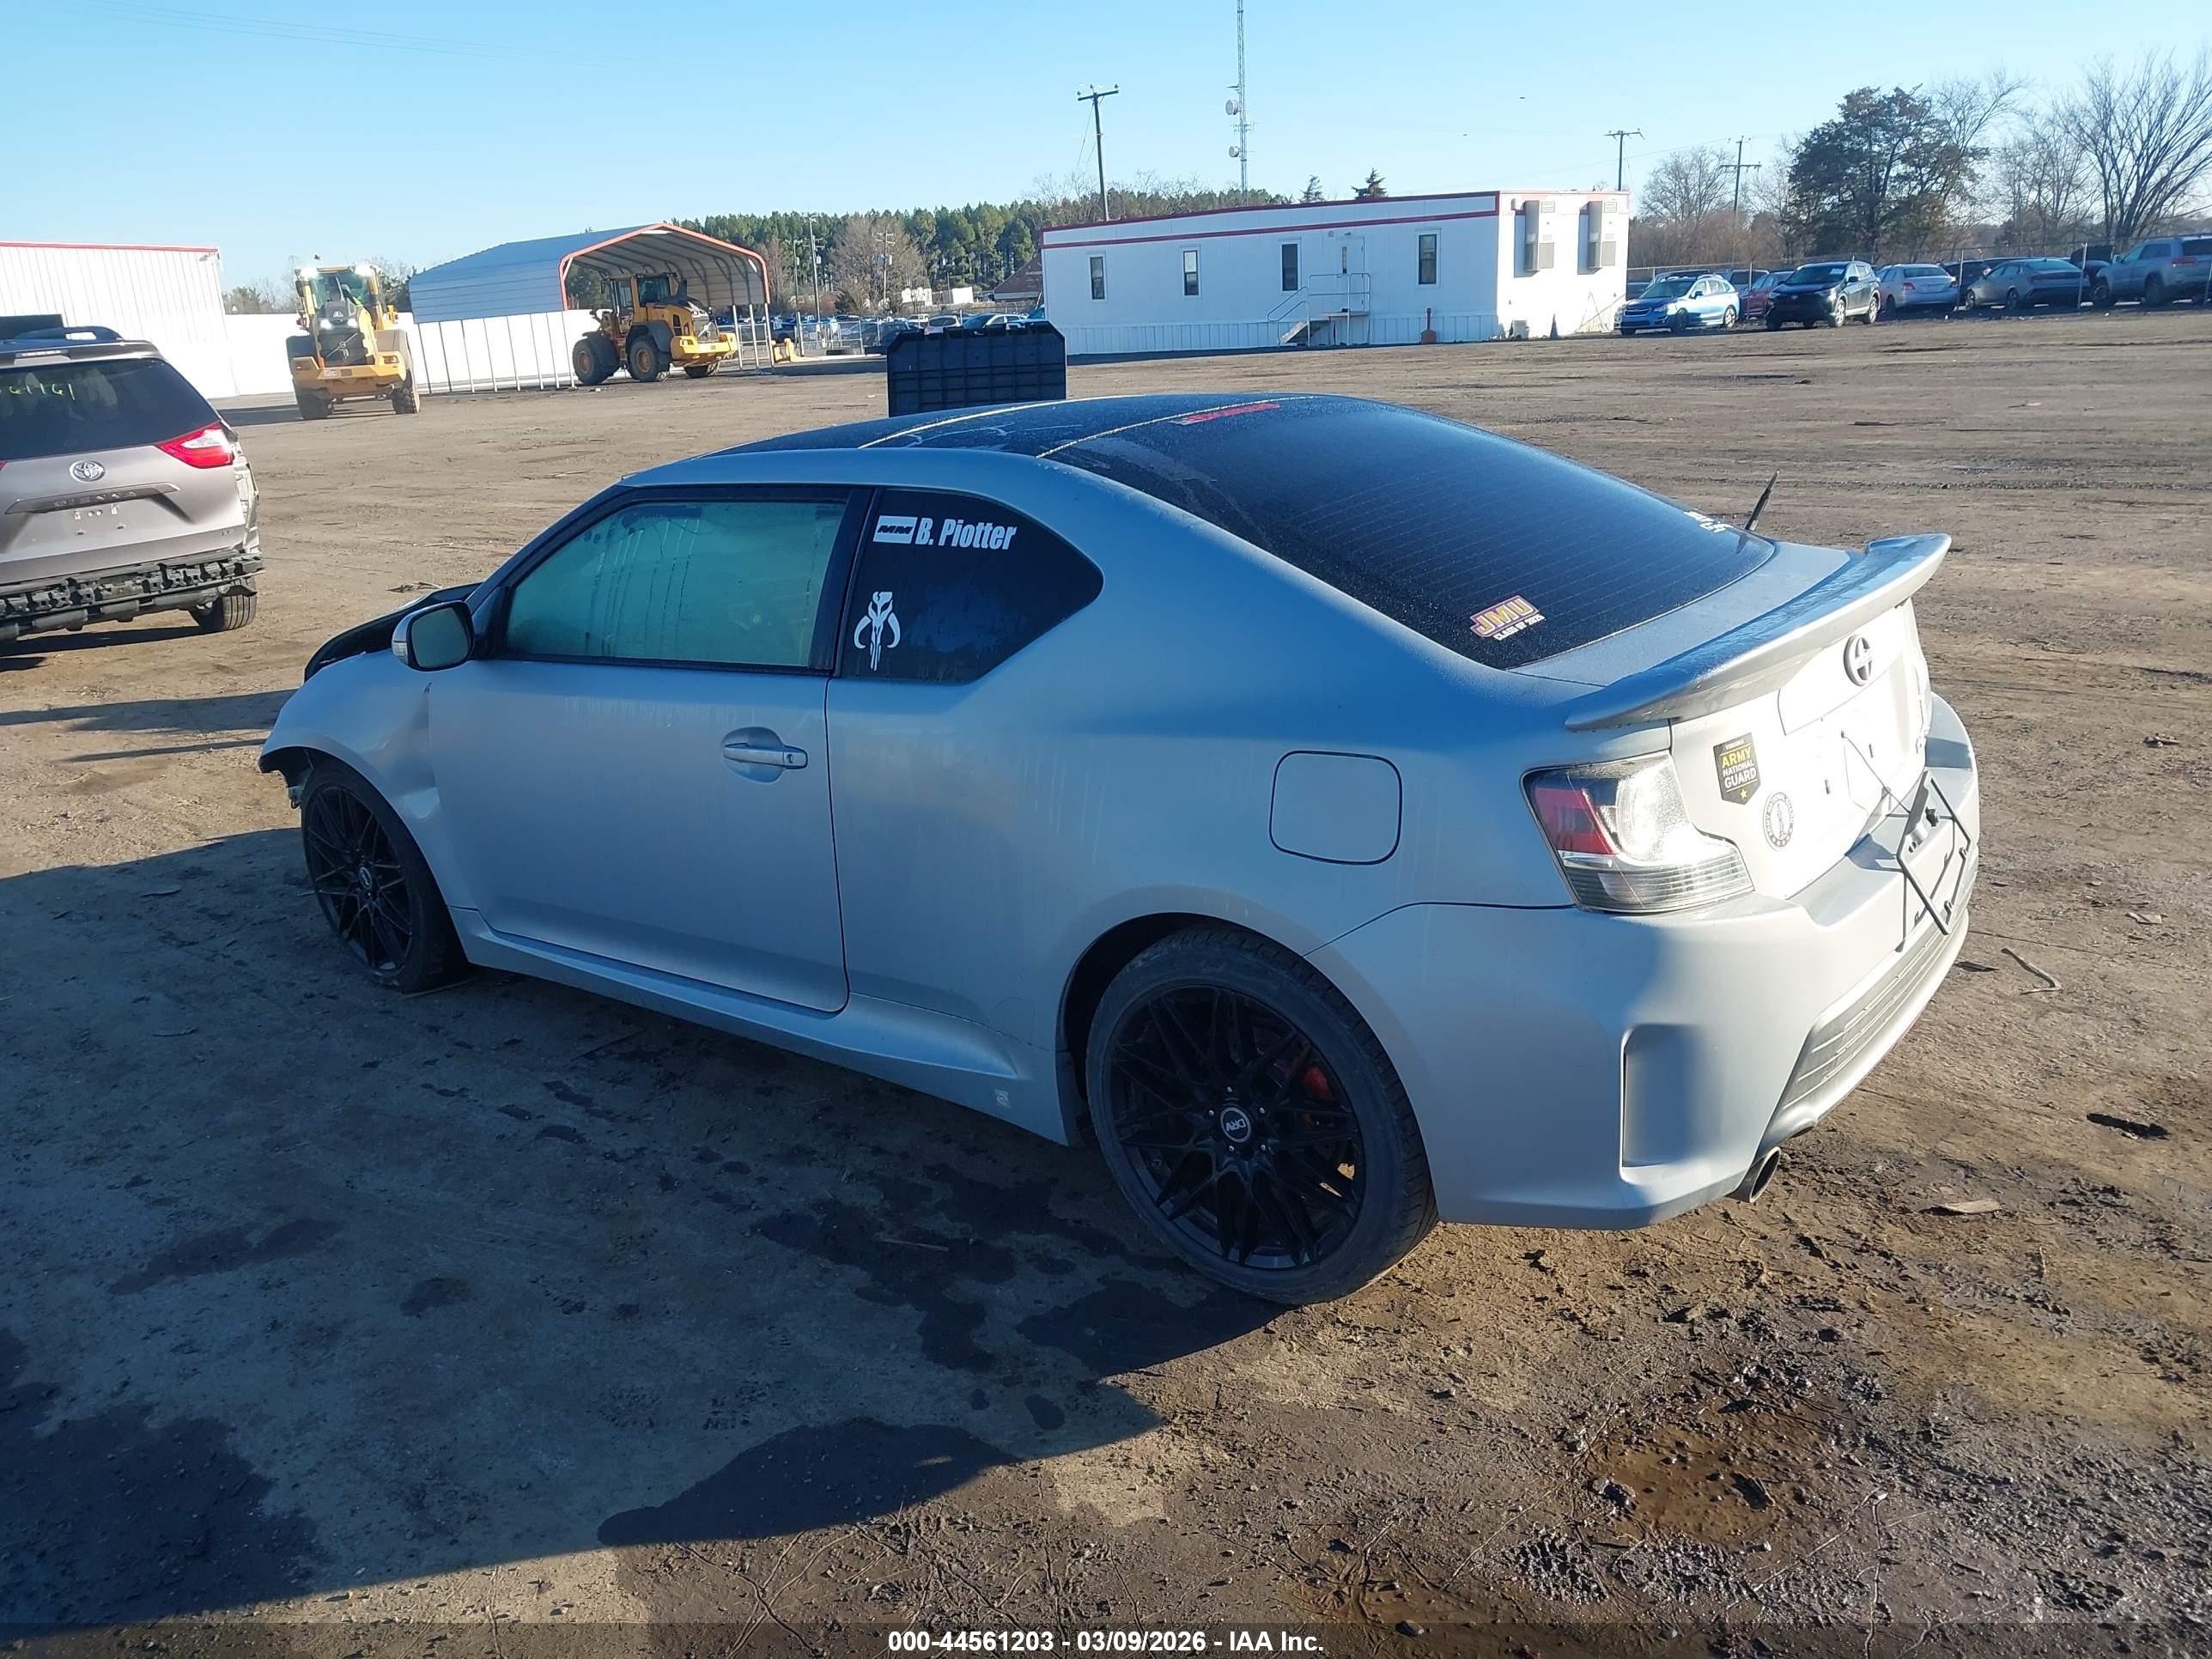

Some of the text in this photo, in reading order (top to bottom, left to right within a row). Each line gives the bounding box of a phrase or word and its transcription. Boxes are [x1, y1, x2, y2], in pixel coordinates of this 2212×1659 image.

[915, 517, 934, 545] B.
[938, 519, 1017, 550] Piotter
[1475, 598, 1534, 635] JMU
[1723, 746, 1752, 769] ARMY
[1723, 759, 1755, 777] NATIONAL
[1724, 767, 1757, 789] GUARD
